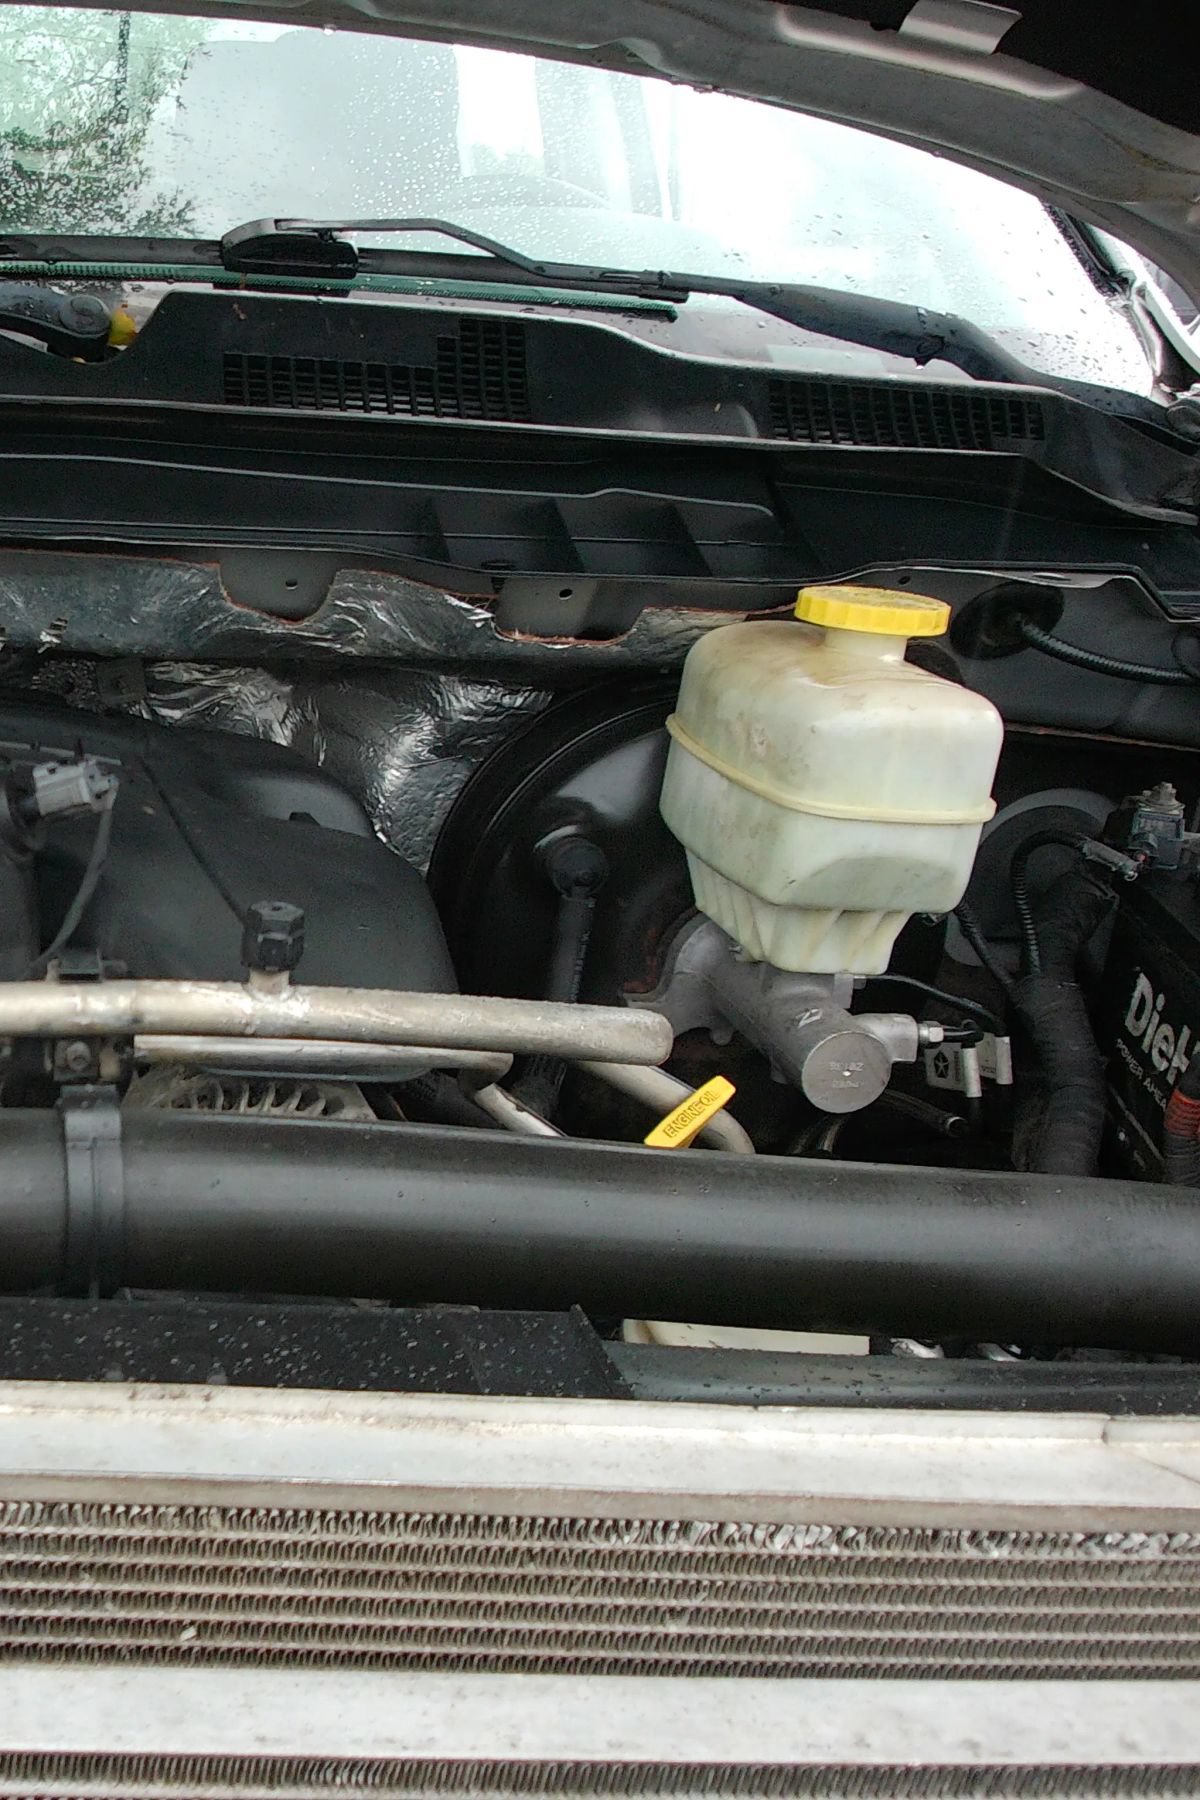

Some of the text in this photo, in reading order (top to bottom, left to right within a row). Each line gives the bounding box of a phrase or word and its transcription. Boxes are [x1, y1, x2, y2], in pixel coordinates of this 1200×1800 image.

[1116, 1038, 1144, 1080] POWER
[662, 1090, 721, 1138] ENGINE OIL
